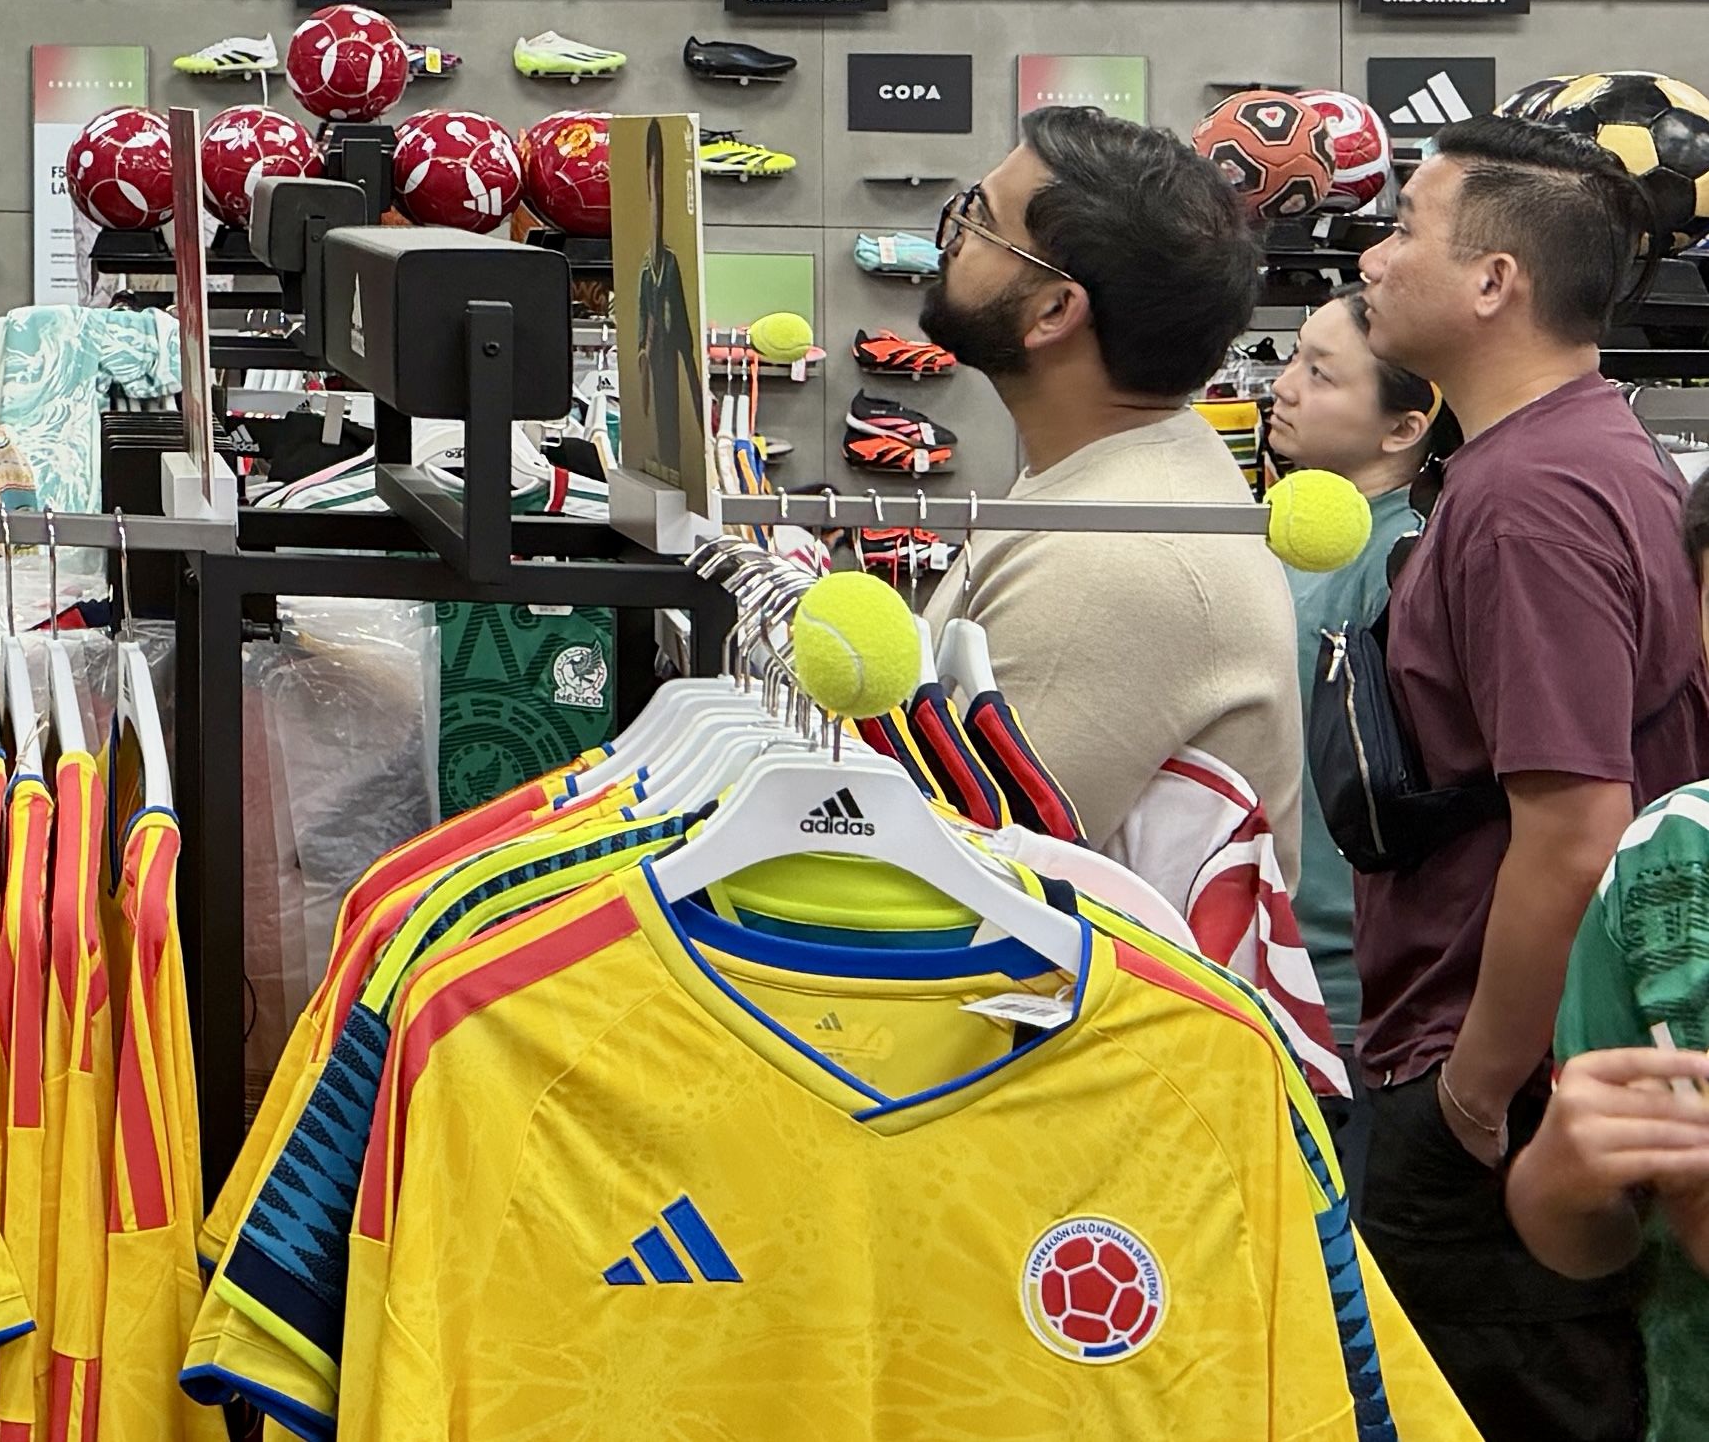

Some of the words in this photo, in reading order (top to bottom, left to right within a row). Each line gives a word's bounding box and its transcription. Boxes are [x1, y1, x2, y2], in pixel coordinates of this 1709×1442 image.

[878, 84, 942, 100] COPA
[799, 817, 876, 838] adidas
[1070, 1222, 1135, 1251] COLOMBIANA
[1132, 1248, 1148, 1264] DE
